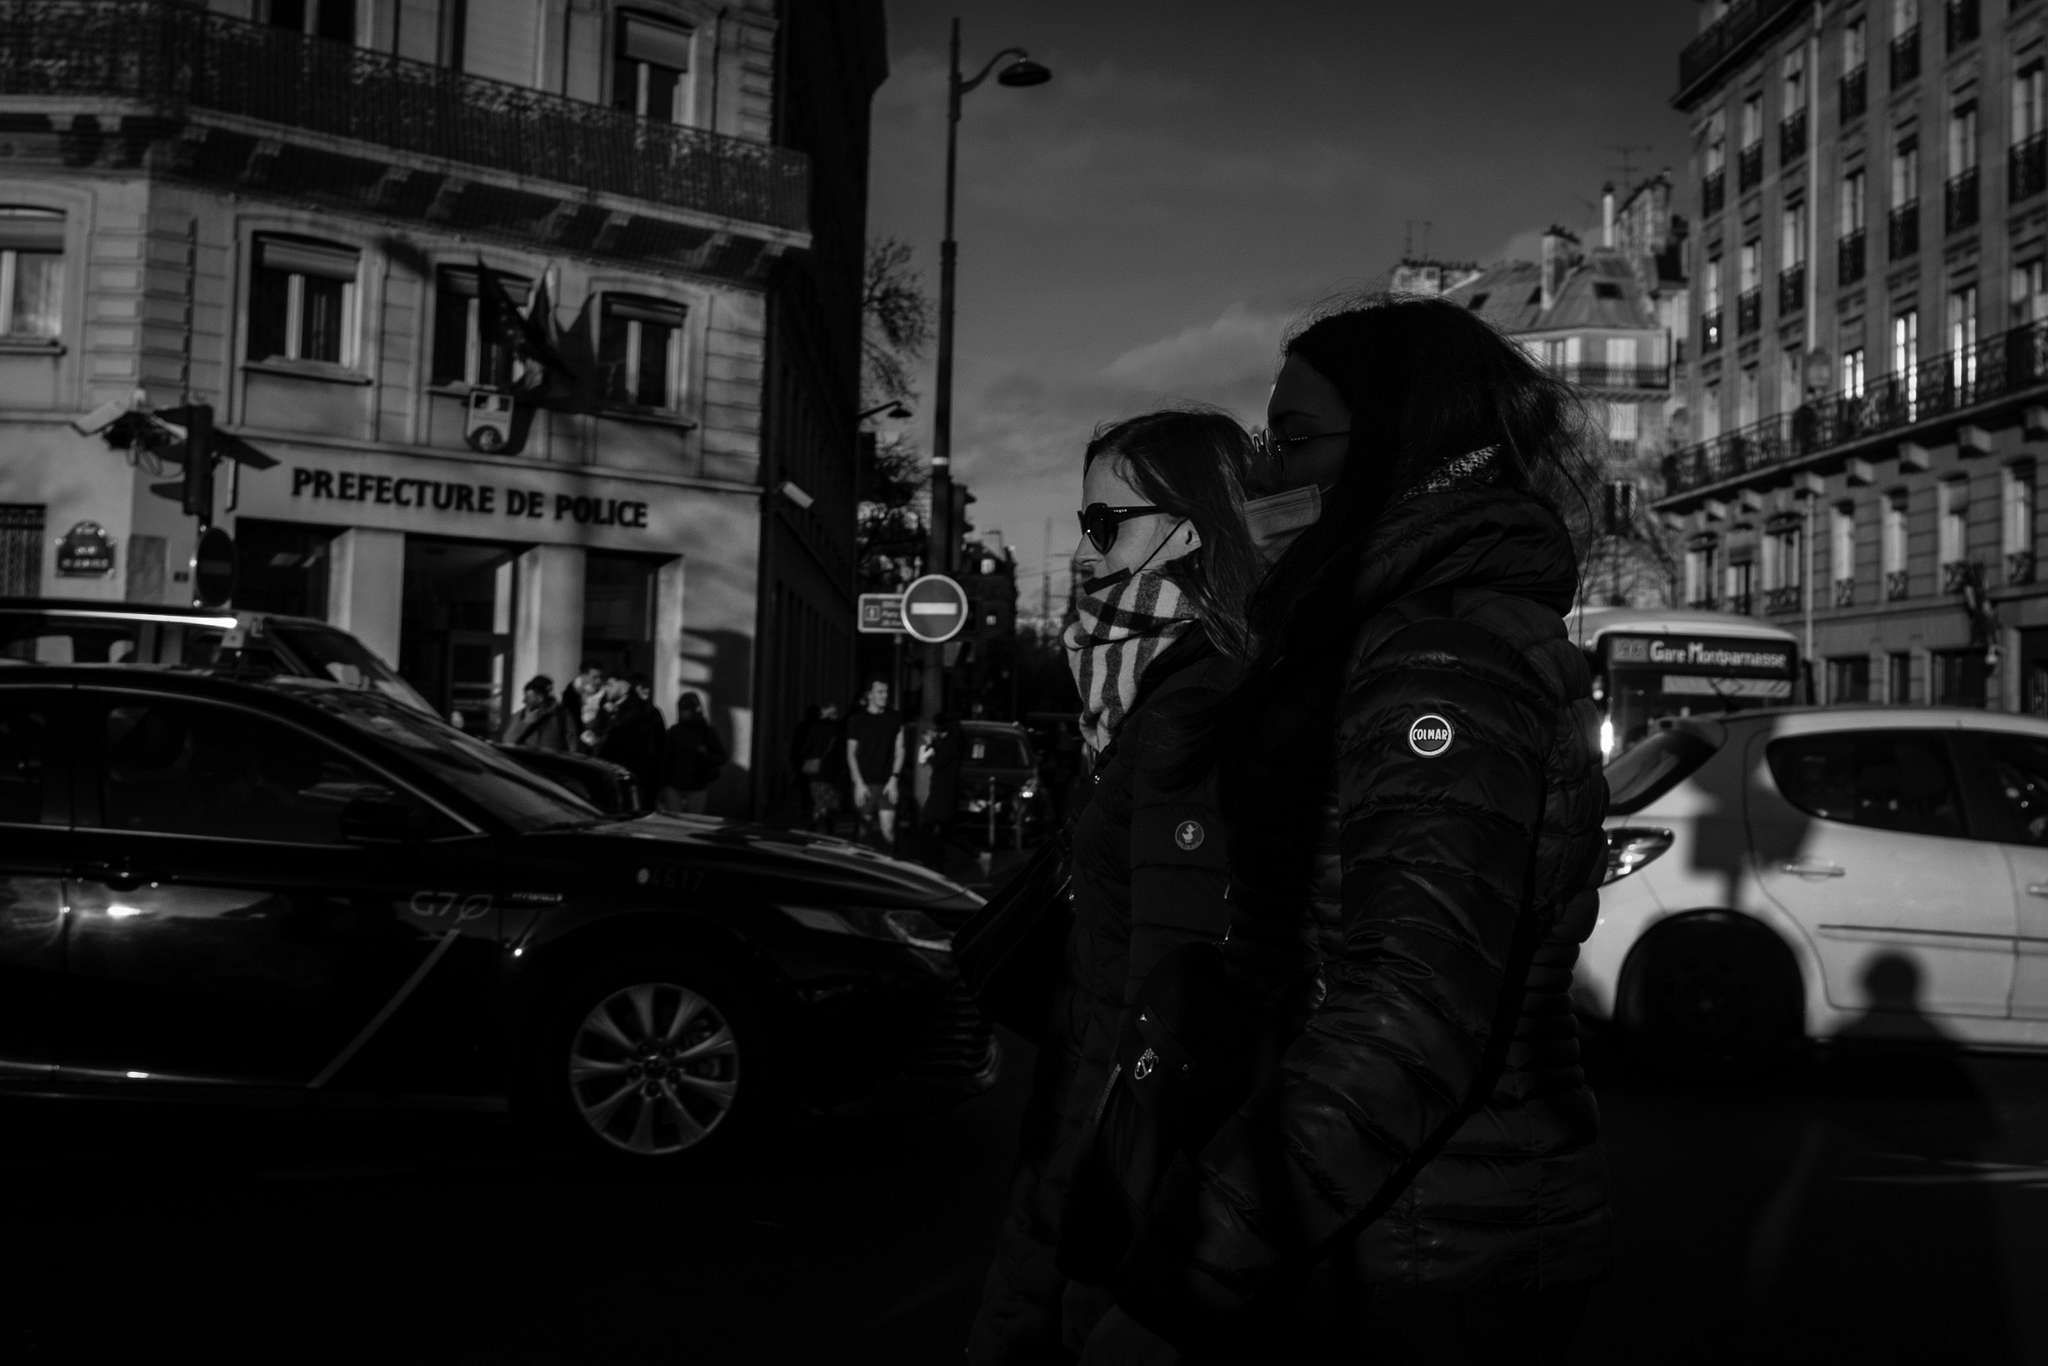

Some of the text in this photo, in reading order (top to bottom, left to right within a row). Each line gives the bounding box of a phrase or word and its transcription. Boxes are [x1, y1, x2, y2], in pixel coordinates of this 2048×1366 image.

[292, 467, 648, 528] PREFECTURE DE POLICE
[1650, 639, 1687, 664] Gare
[1688, 641, 1787, 670] Montparnasse
[1412, 728, 1448, 741] COLMAR
